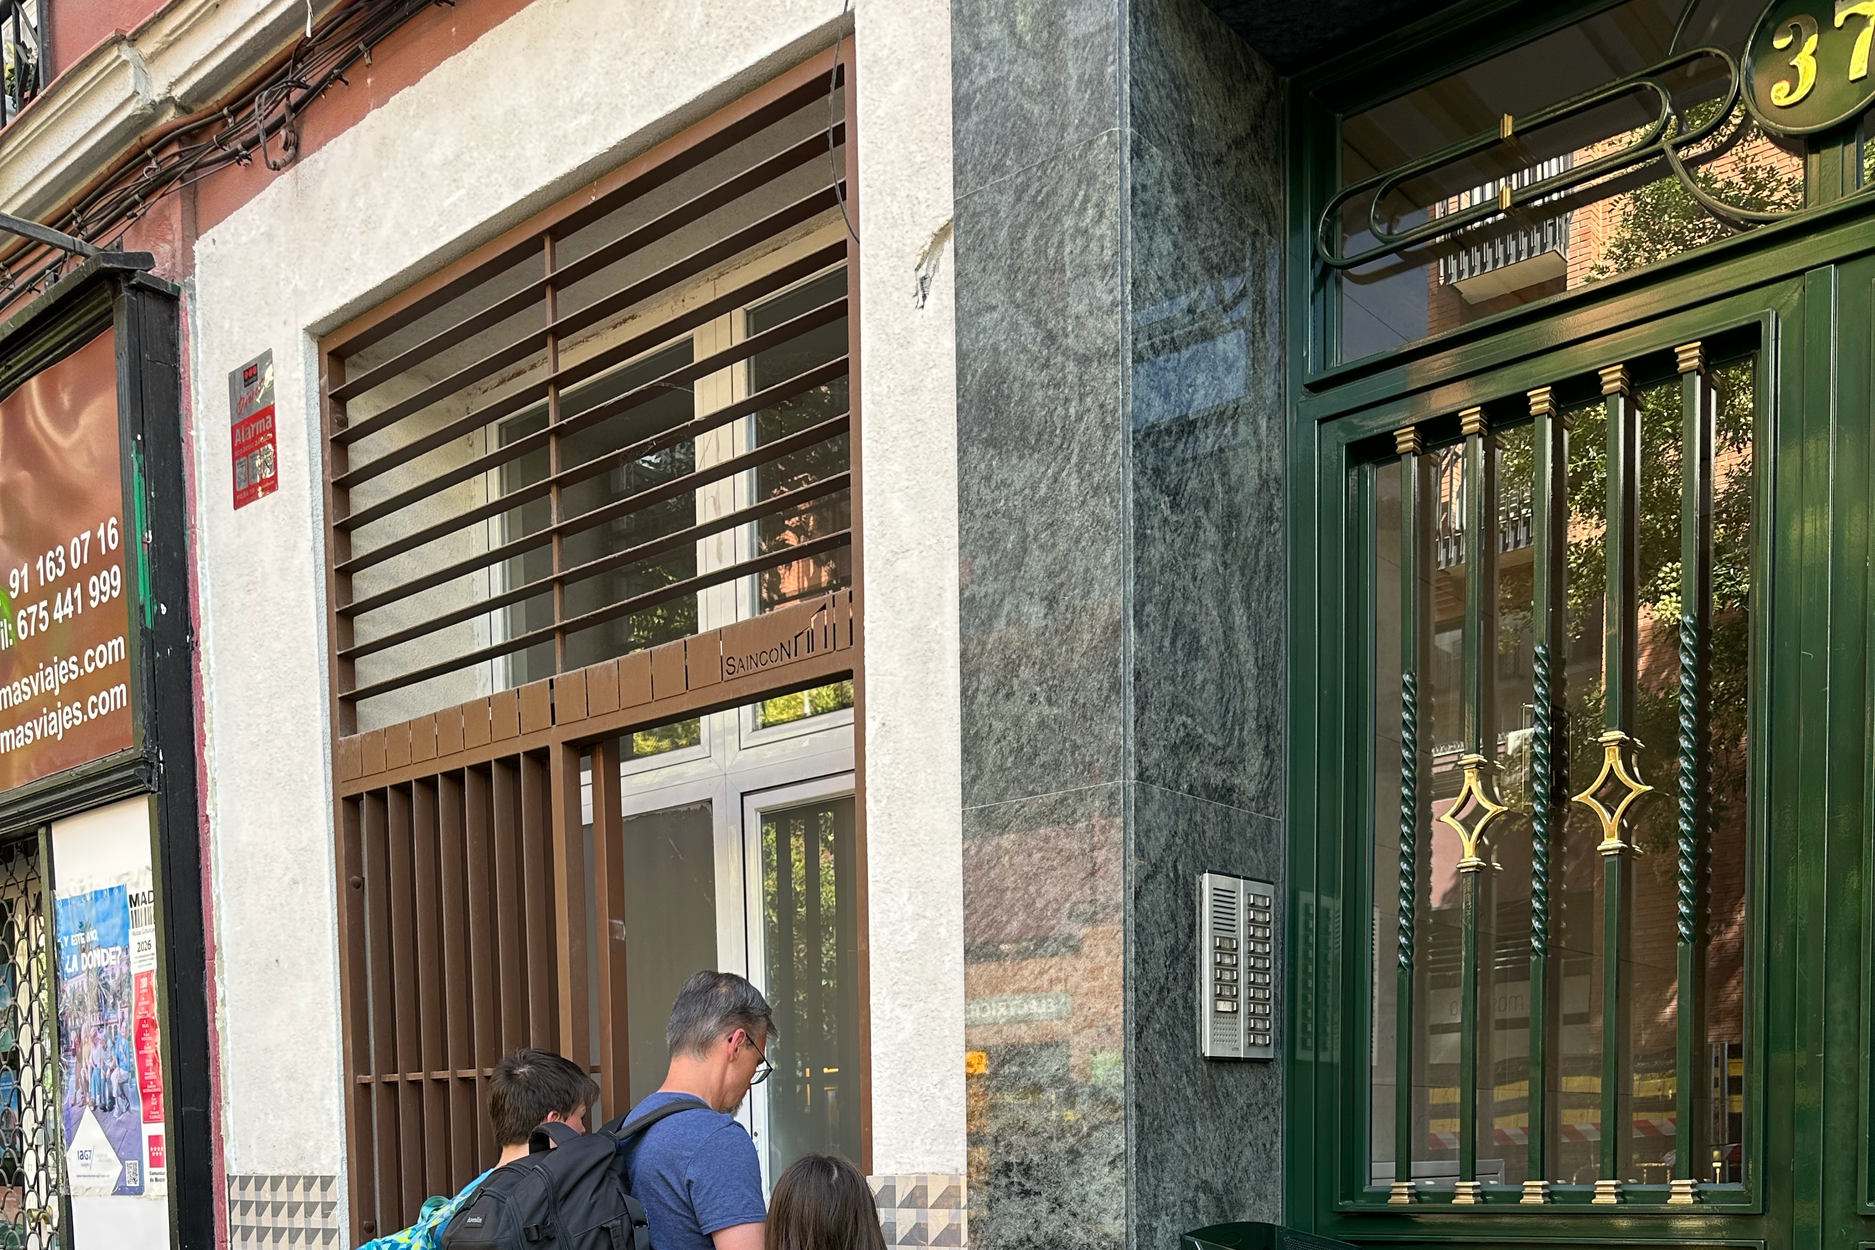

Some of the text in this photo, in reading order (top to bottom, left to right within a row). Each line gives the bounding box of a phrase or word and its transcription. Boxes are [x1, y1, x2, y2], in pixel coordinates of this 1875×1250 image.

[1770, 0, 1875, 107] 37
[234, 414, 273, 447] Alarma
[9, 516, 119, 599] 91 163 07 16
[17, 599, 50, 641] 675
[53, 582, 82, 623] 441
[88, 564, 122, 609] 999
